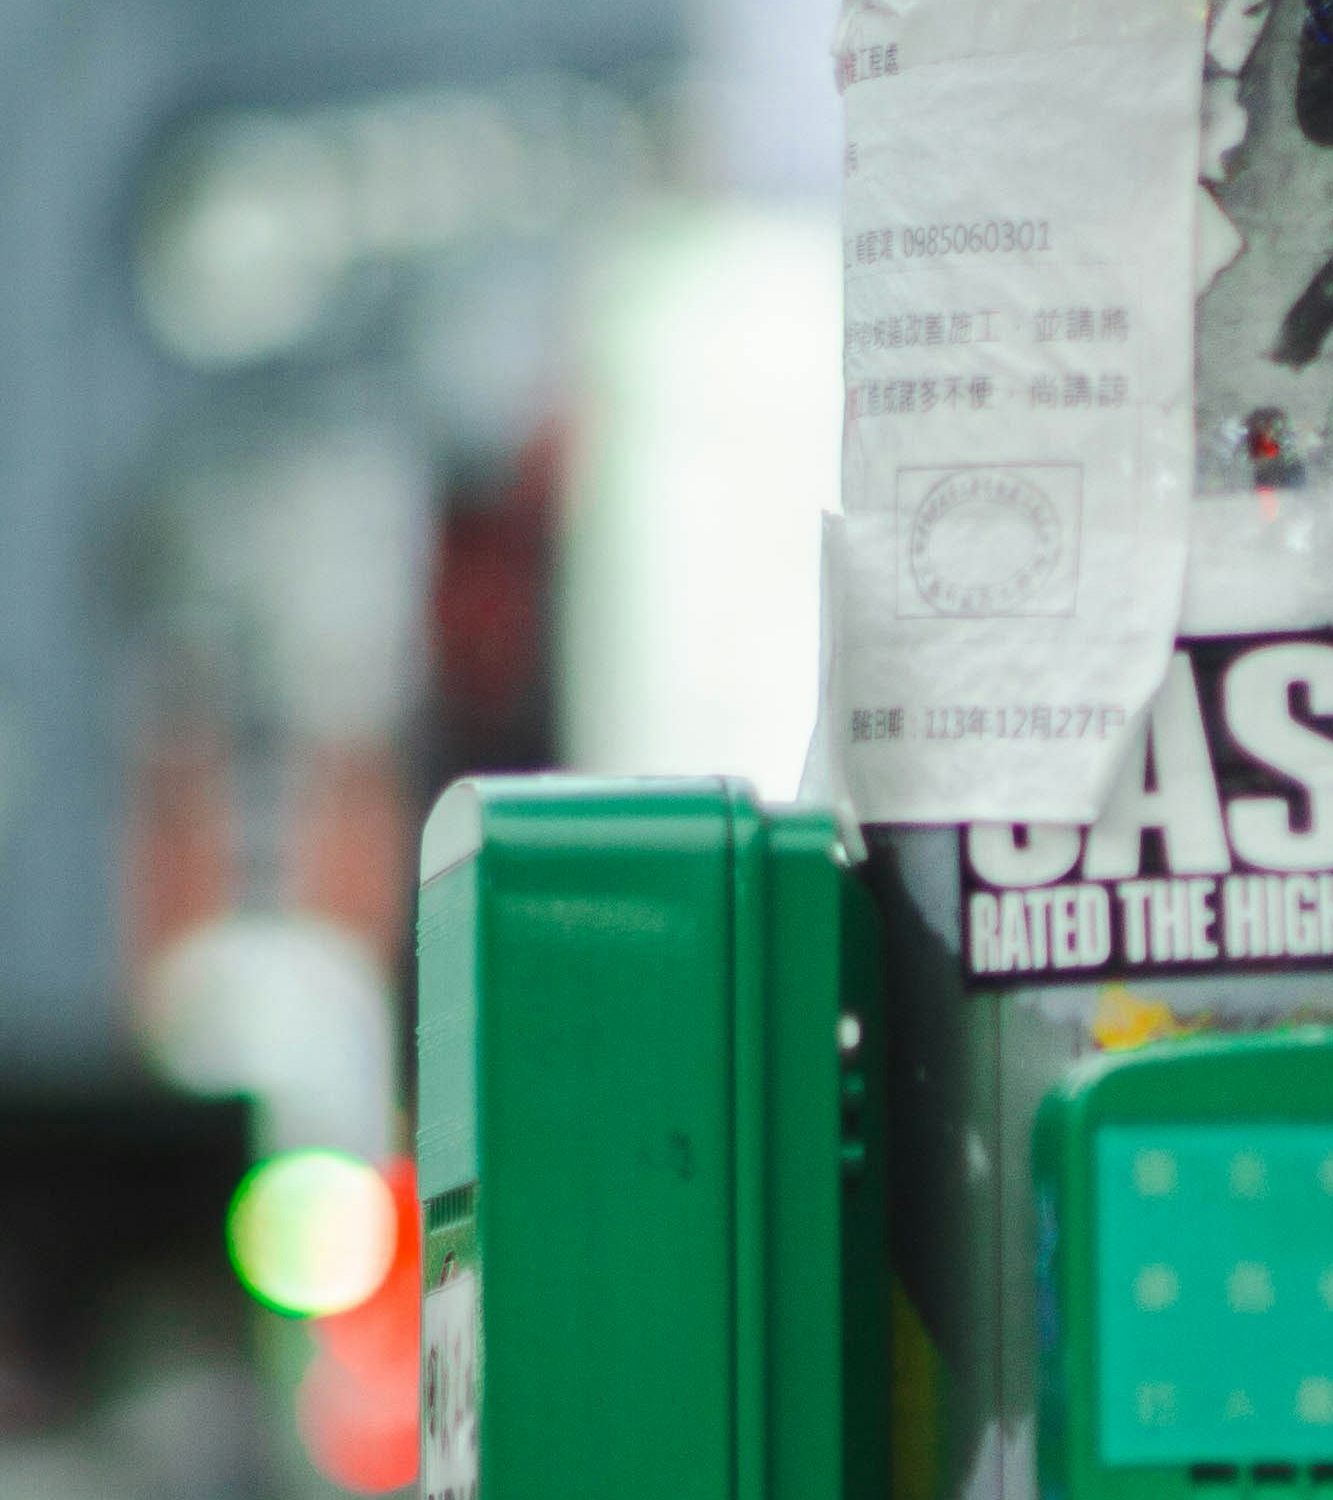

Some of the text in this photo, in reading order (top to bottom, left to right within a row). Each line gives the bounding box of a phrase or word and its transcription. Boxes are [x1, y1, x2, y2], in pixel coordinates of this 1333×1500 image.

[902, 220, 1052, 259] 0985060301
[969, 889, 1109, 975] RATED
[1118, 878, 1220, 965] THE
